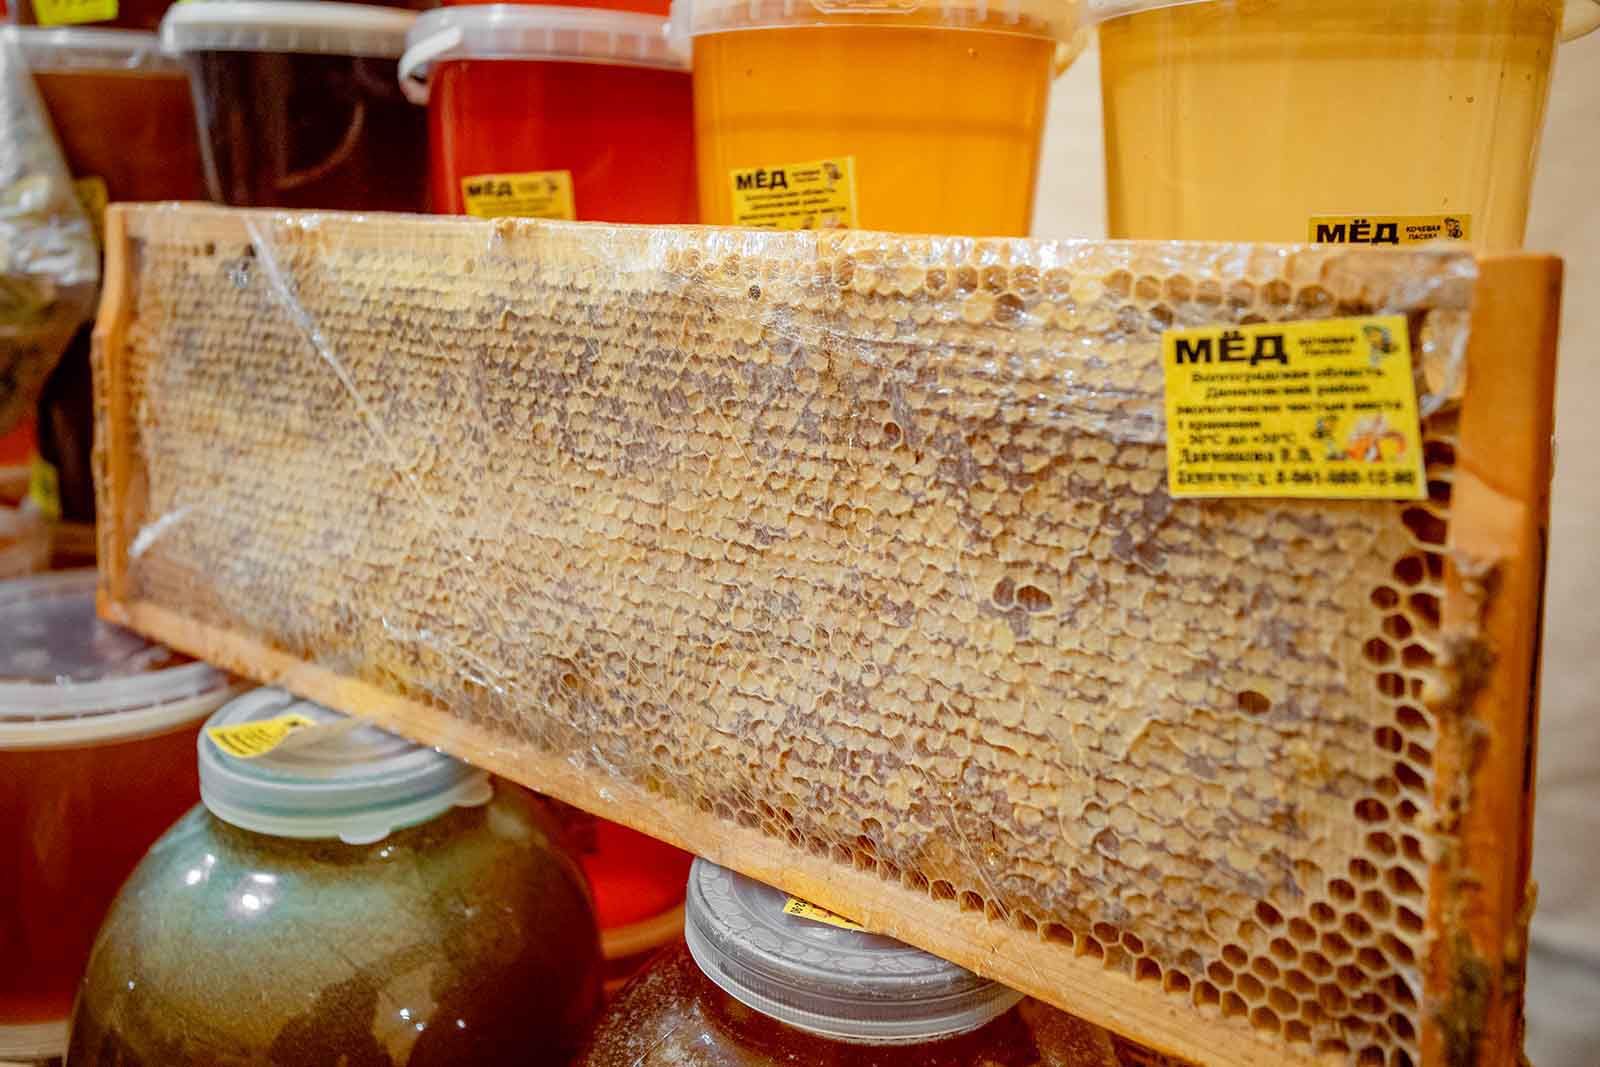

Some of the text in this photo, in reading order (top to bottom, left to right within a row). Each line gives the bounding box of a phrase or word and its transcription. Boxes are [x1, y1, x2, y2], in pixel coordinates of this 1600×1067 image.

[737, 169, 788, 190] МЁД
[1317, 219, 1399, 245] МЁД
[1175, 330, 1288, 366] МЁД
